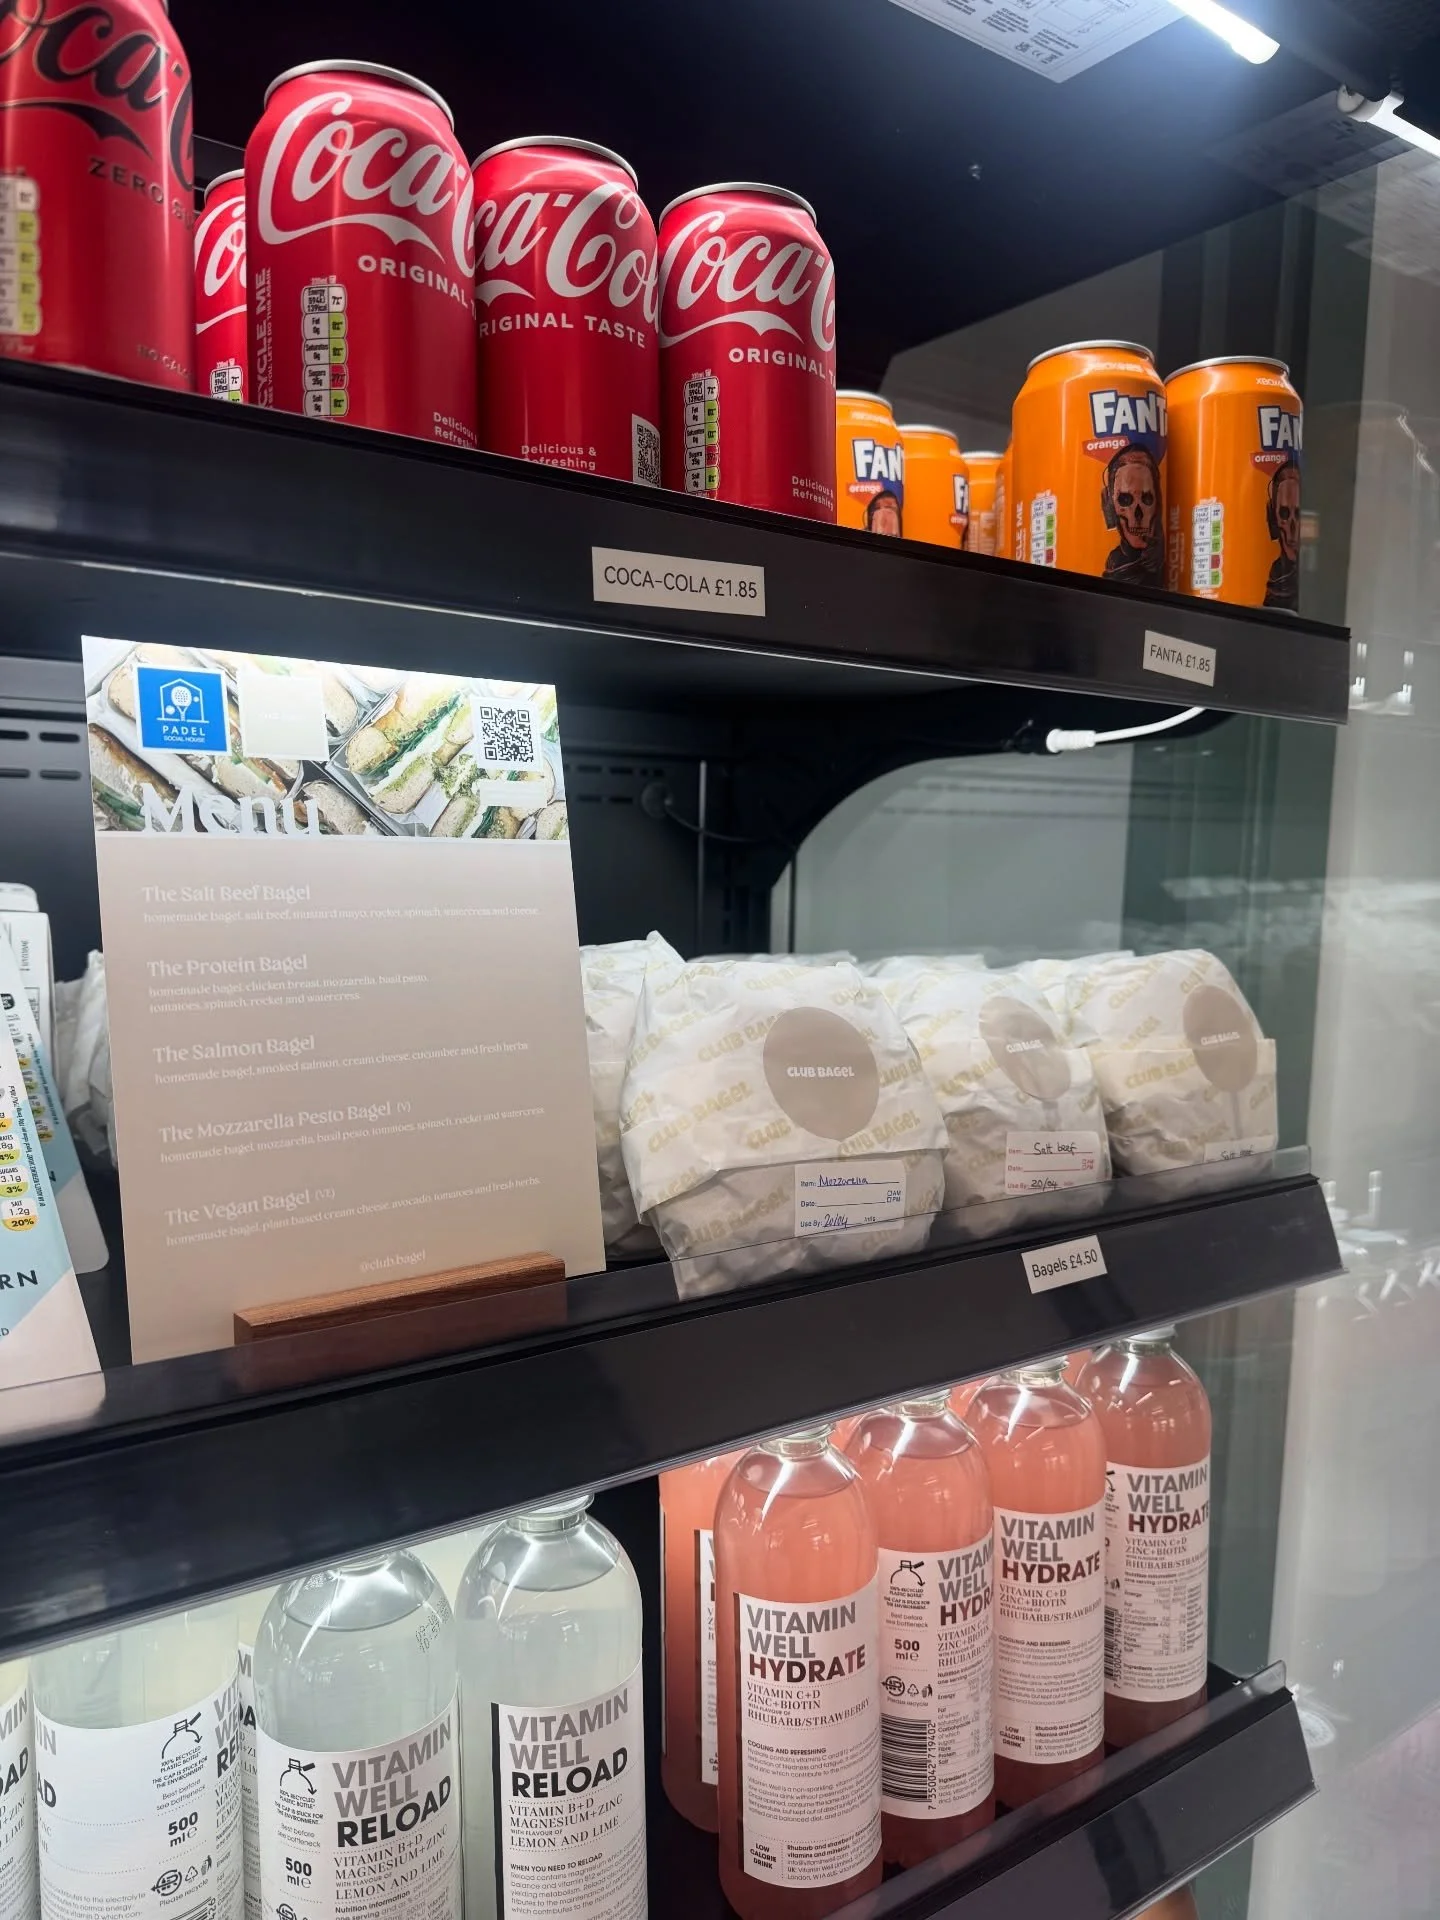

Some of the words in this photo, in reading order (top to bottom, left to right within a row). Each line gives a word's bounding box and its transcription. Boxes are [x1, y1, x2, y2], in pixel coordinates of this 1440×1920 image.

[89, 157, 164, 204] ZERO
[256, 268, 267, 314] ME
[357, 255, 468, 309] ORIGINAL
[584, 314, 646, 349] TASTE
[255, 319, 268, 408] CYCLE
[729, 347, 826, 379] ORIGINAL
[1090, 390, 1168, 438] FANT
[1259, 407, 1303, 451] FAN
[521, 443, 584, 456] Delicious
[588, 446, 597, 457] &
[1087, 438, 1126, 452] orange
[853, 440, 903, 482] FAN
[1254, 454, 1287, 464] orange
[791, 475, 831, 497] Delicious
[792, 488, 834, 511] Refreshing
[849, 483, 881, 494] orange
[604, 565, 710, 594] COCA-COLA
[715, 579, 758, 599] £1.85
[1150, 644, 1183, 665] FANTA
[1185, 654, 1211, 673] £1.85
[162, 725, 206, 737] PADEL
[140, 783, 325, 834] Menu
[141, 885, 177, 903] The
[180, 885, 215, 902] Salt
[220, 884, 261, 902] Beef
[263, 884, 310, 904] Bagel
[146, 960, 183, 977] The
[187, 956, 256, 976] Protein
[260, 953, 308, 974] Bagel
[153, 1047, 192, 1063] The
[193, 1042, 263, 1061] Salmon
[266, 1035, 315, 1055] Bagel
[1006, 1043, 1022, 1053] CLUB
[1201, 1034, 1218, 1046] CLUB
[1218, 1031, 1240, 1043] BAGEL
[155, 1070, 219, 1084] homemade
[256, 1062, 299, 1075] smoked
[343, 1055, 374, 1067] cream
[412, 1048, 459, 1060] cucumber
[460, 1045, 478, 1056] and
[479, 1043, 502, 1055] fresh
[787, 1066, 816, 1078] CLUB
[817, 1066, 855, 1078] BAGEL
[158, 1126, 193, 1143] The
[197, 1113, 294, 1138] Mozzarella
[298, 1108, 344, 1126] Pesto
[348, 1101, 391, 1122] Bagel
[397, 1101, 411, 1113] (V)
[1034, 1142, 1053, 1155] Salt
[1057, 1142, 1077, 1155] beef
[1, 1172, 22, 1184] 3.1g
[6, 1185, 23, 1194] 3%
[1031, 1177, 1058, 1191] 20/04
[9, 1207, 30, 1217] 1.2g
[11, 1199, 23, 1207] SALT
[165, 1208, 200, 1226] The
[203, 1199, 260, 1220] Vegan
[262, 1189, 311, 1211] Bagel
[314, 1187, 336, 1200] (VE)
[11, 1218, 35, 1228] 20%
[801, 1220, 812, 1228] Use
[1032, 1257, 1068, 1278] Bagels
[1069, 1248, 1098, 1269] £4.50
[1127, 1467, 1207, 1494] VITAMIN
[1127, 1493, 1184, 1514] WELL
[1000, 1512, 1095, 1542] VITAMIN
[937, 1540, 993, 1580] VITAM
[1001, 1538, 1063, 1563] WELL
[1002, 1551, 1100, 1585] HYDRATE
[938, 1573, 987, 1603] WELL
[1000, 1584, 1044, 1598] VITAMIN
[1046, 1589, 1067, 1598] C+D
[1000, 1592, 1067, 1607] ZINC+BIOTIN
[747, 1602, 856, 1635] VITAMIN
[940, 1586, 992, 1626] HYDR
[747, 1631, 817, 1659] WELL
[894, 1639, 920, 1651] 500
[749, 1644, 866, 1684] HYDRATE
[747, 1682, 793, 1700] VITAMIN
[796, 1689, 820, 1700] C+D
[747, 1692, 821, 1710] ZINC+BIOTIN
[508, 1688, 629, 1742] VITAMIN
[747, 1698, 870, 1727] RHUBARB/STRAWBERRY
[332, 1714, 451, 1789] VITAMIN
[509, 1739, 590, 1771] WELL
[748, 1739, 774, 1753] COOLING
[775, 1747, 789, 1755] AND
[512, 1746, 628, 1798] RELOAD
[333, 1774, 419, 1818] WELL
[509, 1804, 564, 1817] VITAMIN
[568, 1798, 594, 1813] B+D
[168, 1811, 199, 1836] 500
[337, 1775, 452, 1848] RELOAD
[510, 1793, 623, 1829] MAGNESIUM+ZINC
[511, 1836, 556, 1848] LEMON
[561, 1832, 589, 1847] AND
[593, 1815, 619, 1838] LIME
[333, 1849, 393, 1867] VITAMIN
[398, 1833, 423, 1850] B+D
[335, 1824, 448, 1880] MAGNESIUM+ZINC
[750, 1848, 777, 1863] CALORIE
[755, 1843, 770, 1853] LOW
[285, 1857, 312, 1877] 500
[336, 1881, 387, 1900] LEMON
[390, 1868, 418, 1889] AND
[421, 1846, 445, 1875] LIME
[510, 1863, 530, 1872] WHEN
[531, 1864, 547, 1873] YOU
[548, 1864, 566, 1872] NEED
[567, 1861, 577, 1869] TO
[577, 1853, 603, 1867] RELOAD
[753, 1857, 773, 1870] DRINK
[335, 1901, 368, 1914] Nutrition
[369, 1890, 410, 1909] information
